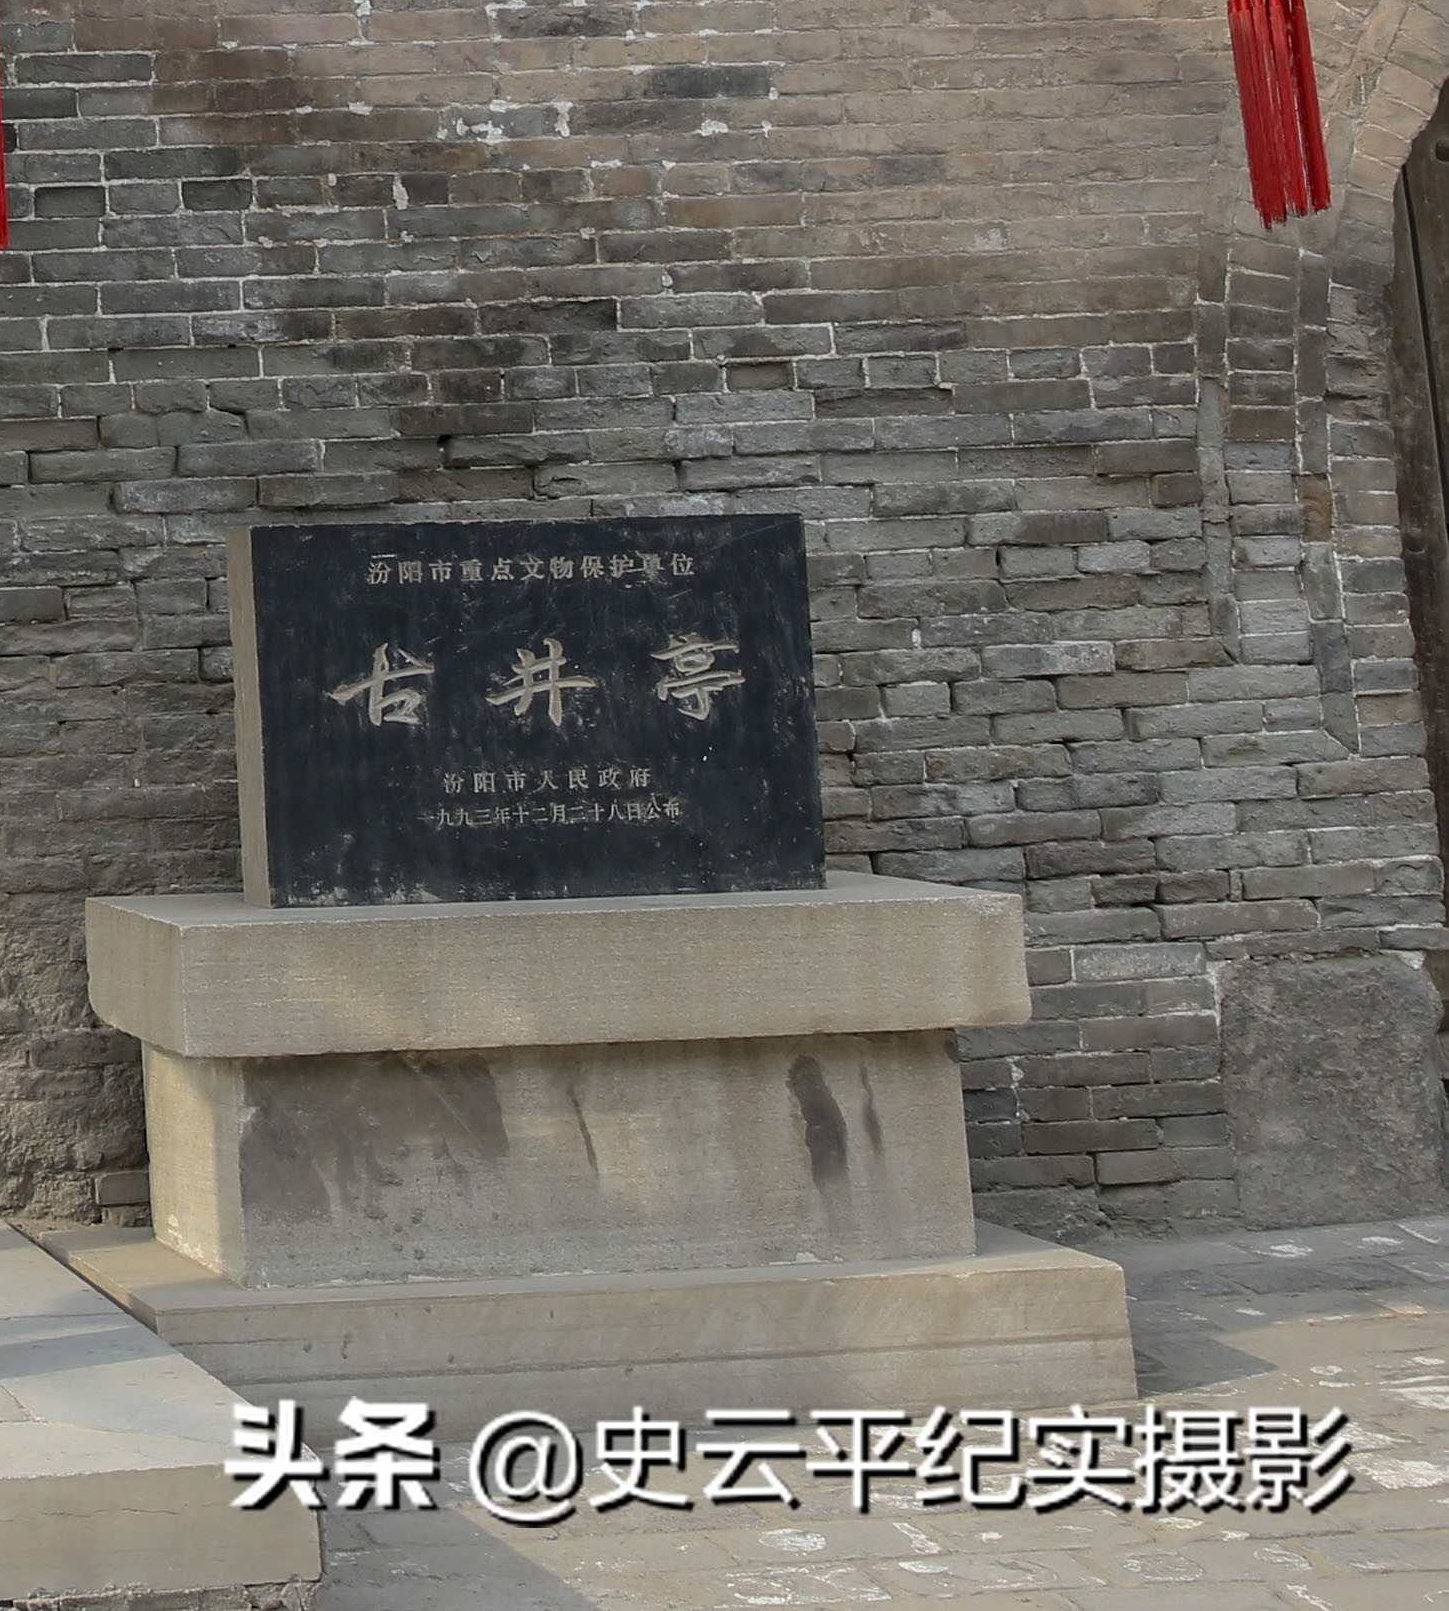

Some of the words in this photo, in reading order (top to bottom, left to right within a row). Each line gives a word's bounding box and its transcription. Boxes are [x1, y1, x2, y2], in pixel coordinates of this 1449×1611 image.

[367, 552, 696, 585] 汾阳市重点文物保护单位
[325, 633, 747, 727] 古井亭
[443, 767, 653, 794] 汾阳市人民政府
